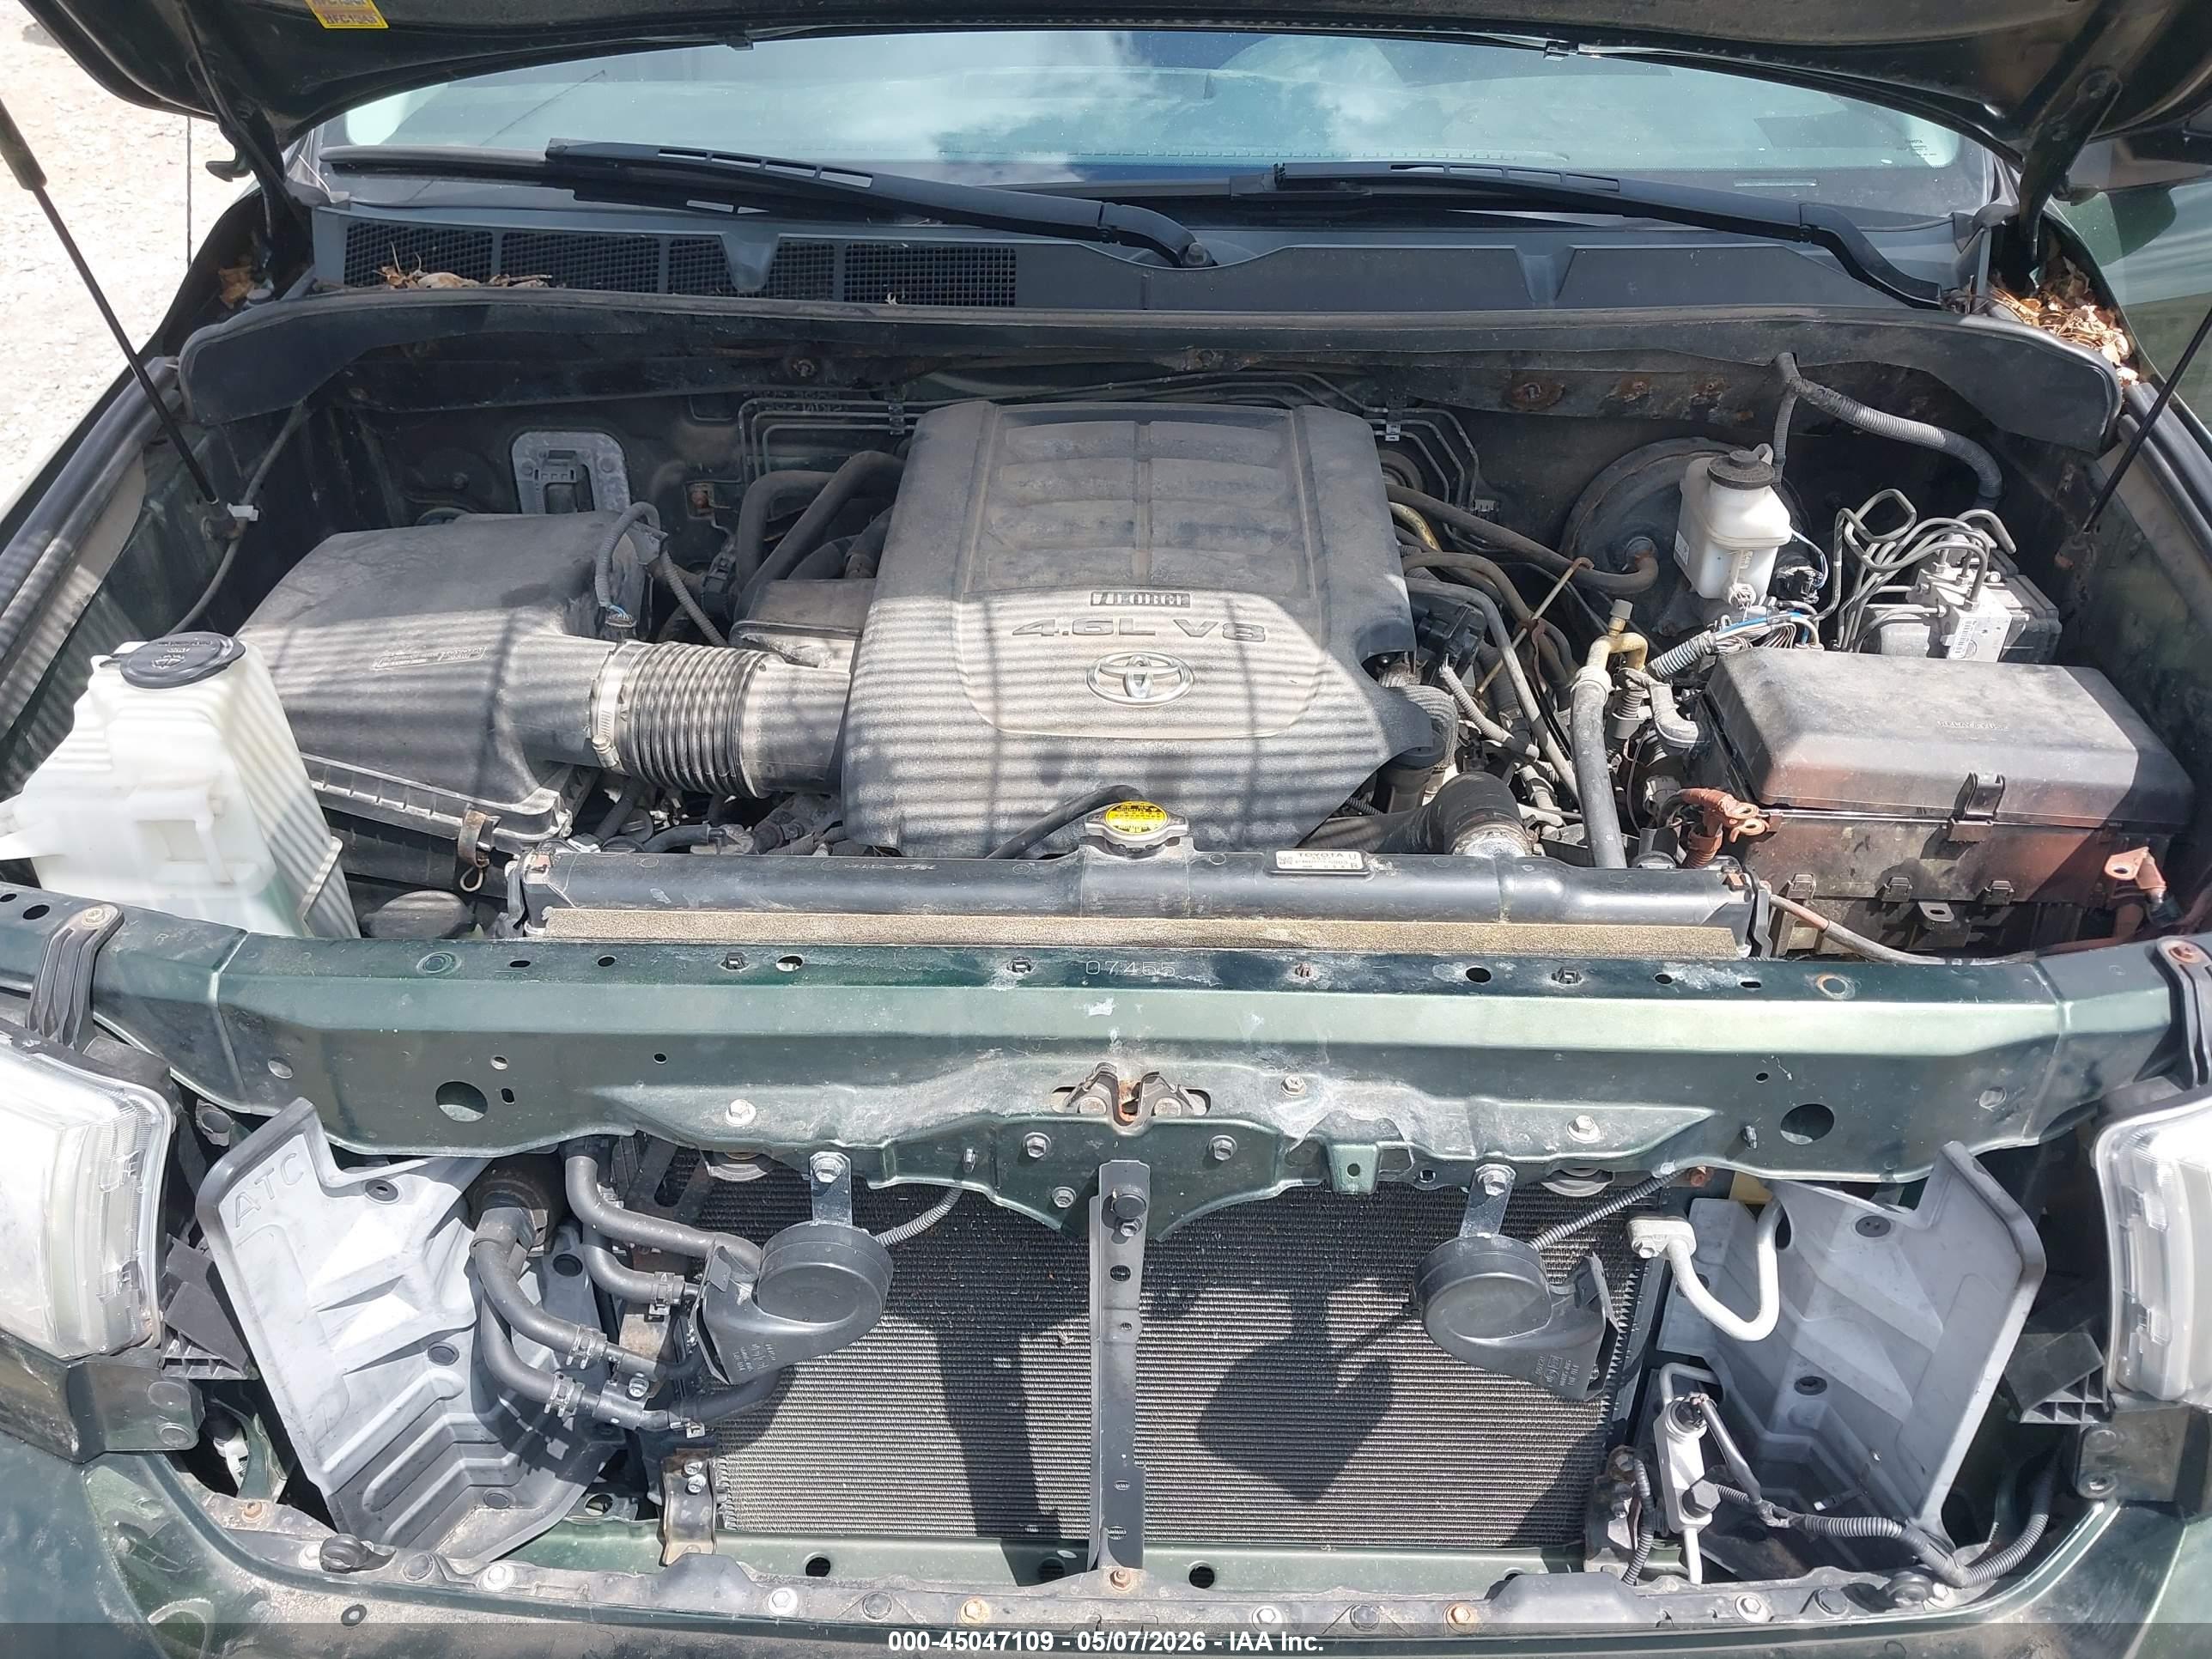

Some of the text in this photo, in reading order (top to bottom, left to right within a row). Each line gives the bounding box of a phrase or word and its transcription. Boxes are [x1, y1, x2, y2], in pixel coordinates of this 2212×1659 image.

[1012, 617, 1266, 642] 4.6L V8
[1085, 960, 1176, 976] 07455
[234, 1152, 305, 1229] ATC
